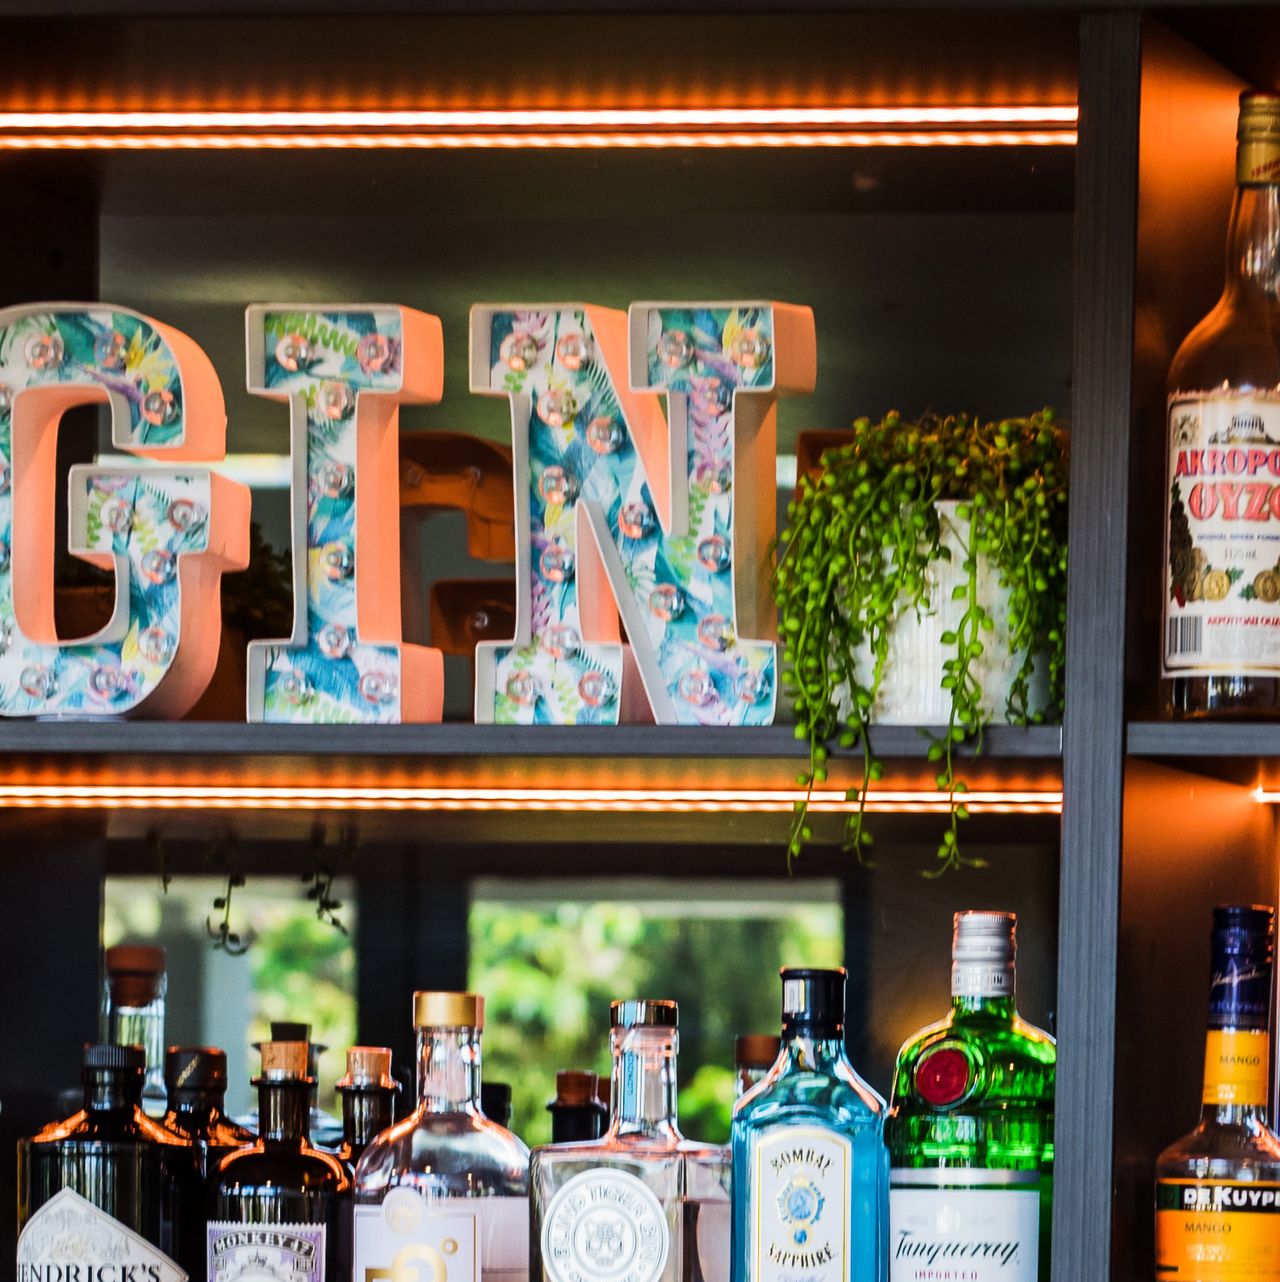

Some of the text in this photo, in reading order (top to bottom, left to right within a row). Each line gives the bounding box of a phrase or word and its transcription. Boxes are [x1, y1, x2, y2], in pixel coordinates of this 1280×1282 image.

[1219, 1055, 1260, 1066] MANGO
[771, 1149, 833, 1176] BOMBAY
[1184, 1188, 1210, 1205] DE
[1185, 1222, 1231, 1234] MANGO
[214, 1231, 312, 1255] MONKEY 47
[896, 1229, 1019, 1266] Tanqueray
[768, 1242, 836, 1268] SAPPHIRE
[915, 1271, 978, 1281] IMPORTED
